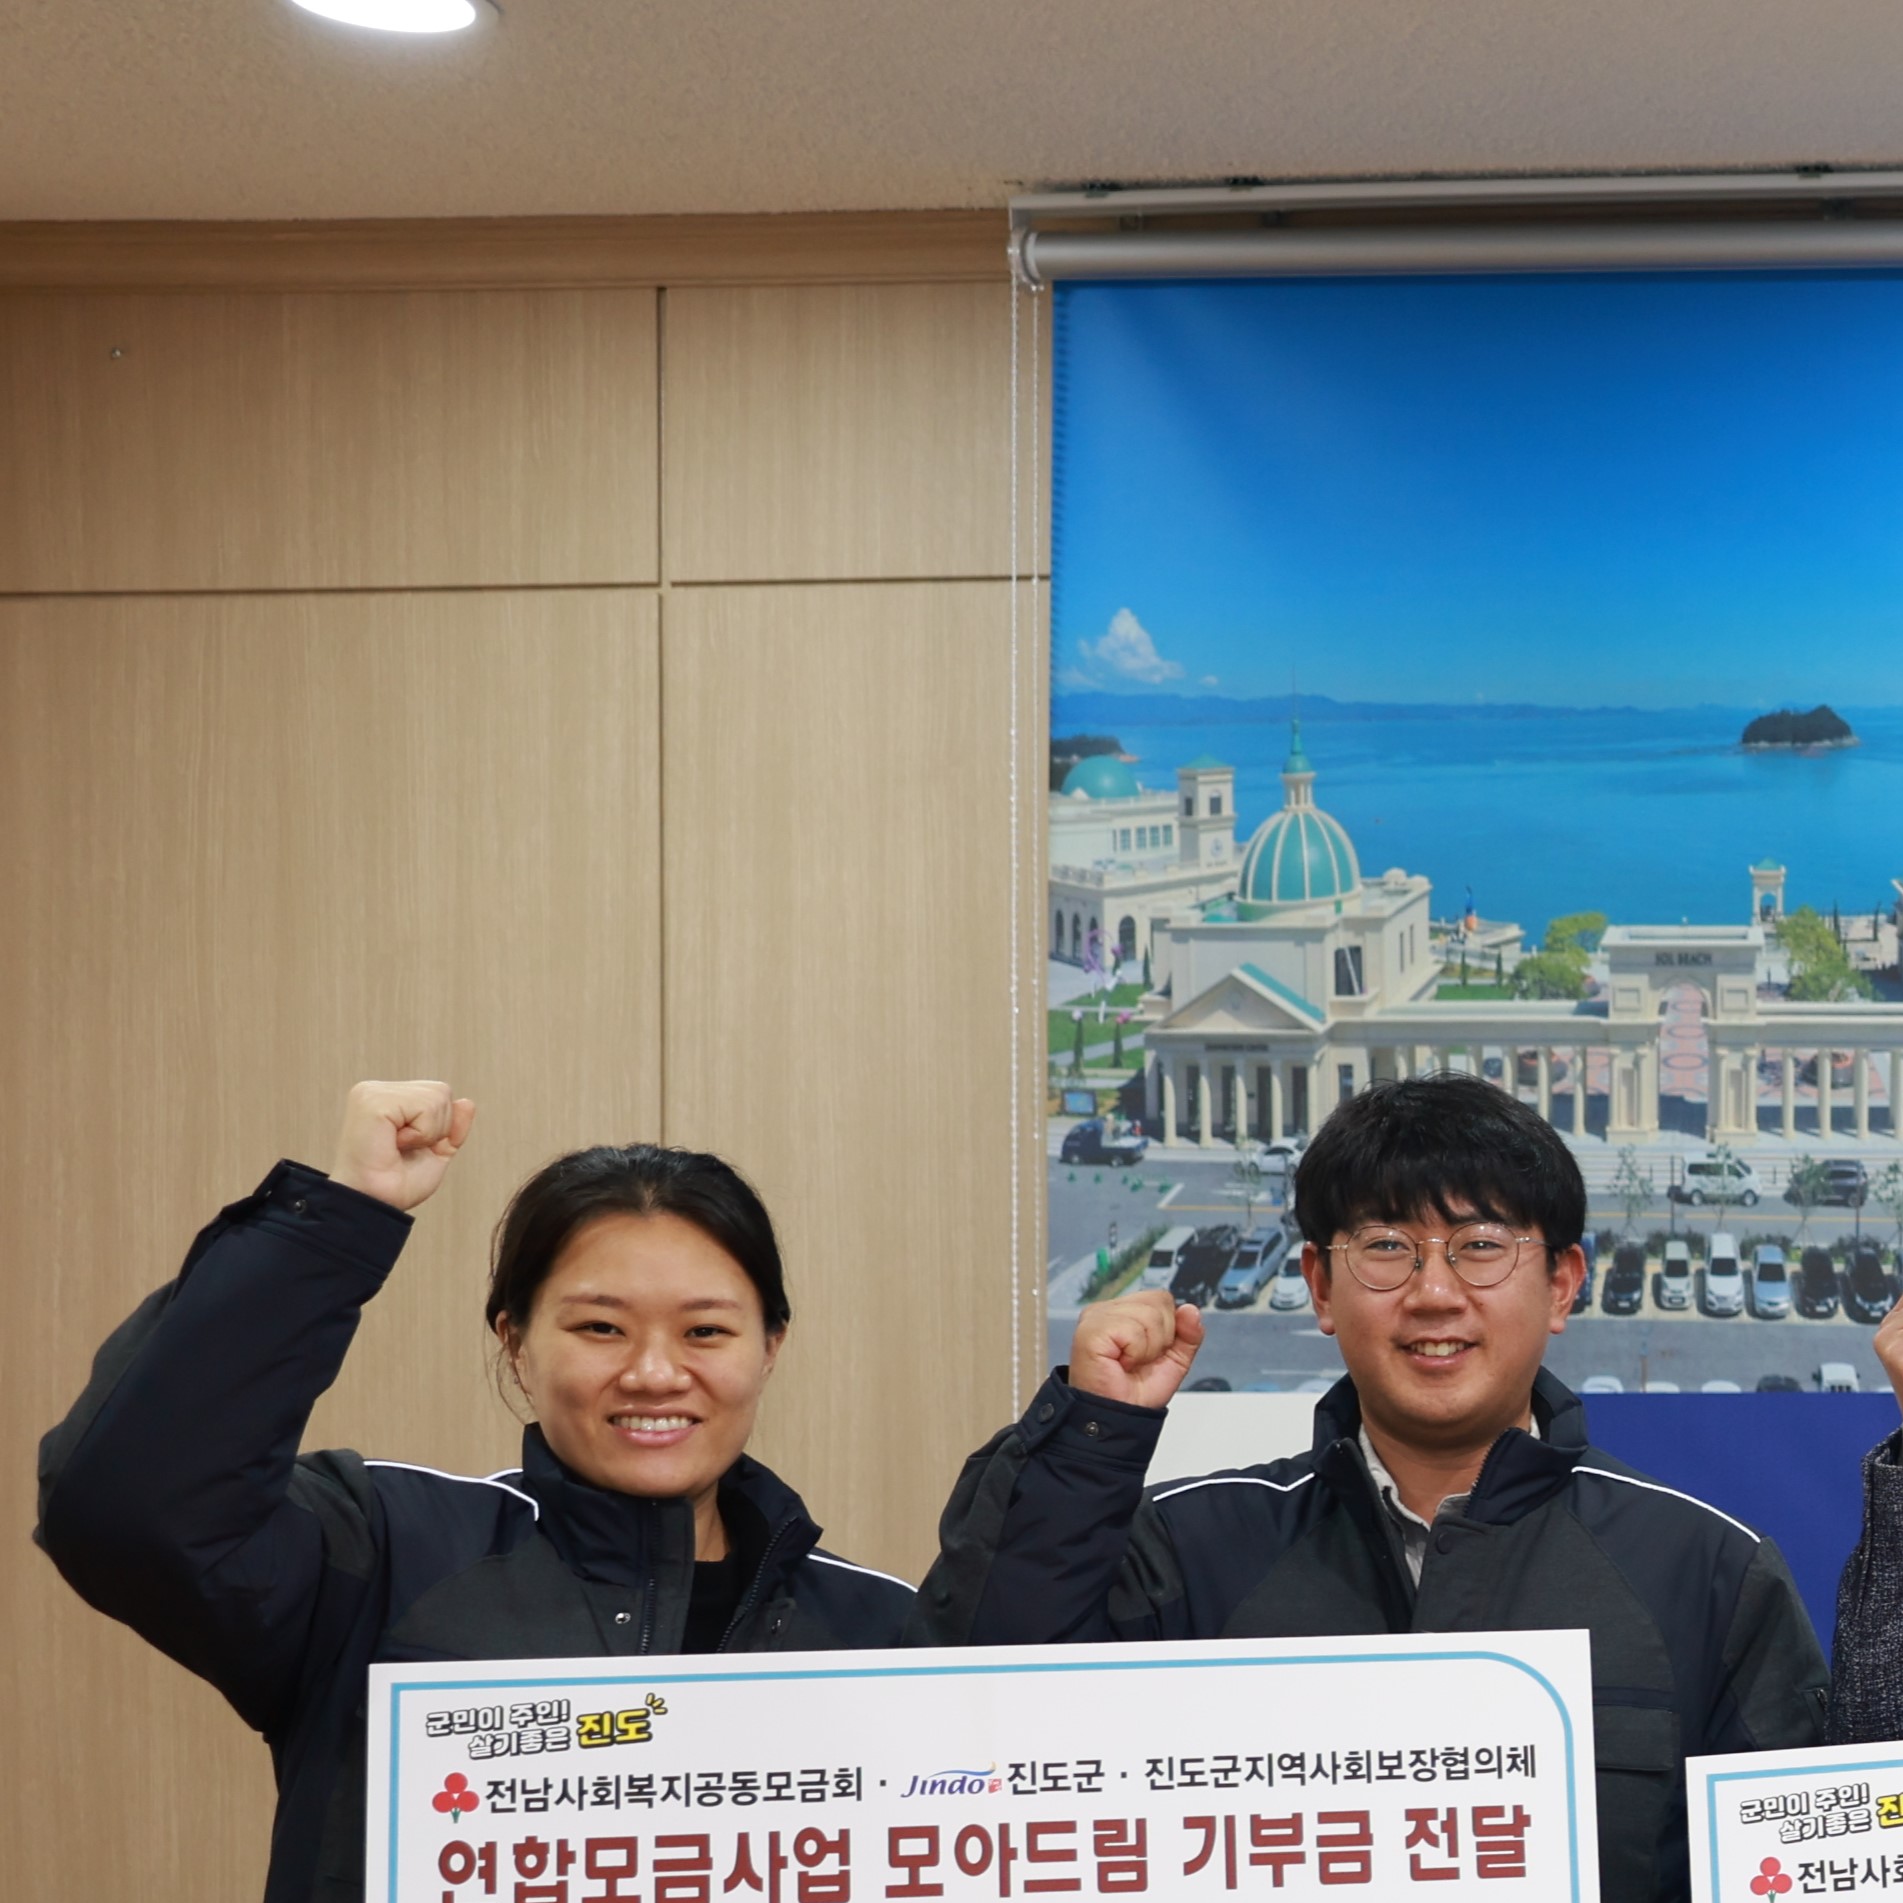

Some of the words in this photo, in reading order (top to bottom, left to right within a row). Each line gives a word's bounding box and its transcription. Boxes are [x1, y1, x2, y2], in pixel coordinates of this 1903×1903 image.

[426, 1706, 503, 1737] 군민이
[510, 1699, 570, 1728] 주인!
[466, 1725, 571, 1760] 살기좋은
[574, 1707, 653, 1750] 진도
[486, 1767, 861, 1813] 전남사회복지공동모금회
[900, 1774, 985, 1798] Jindo
[1008, 1760, 1104, 1795] 진도군
[1145, 1745, 1535, 1790] 진도군지역사회보장협의체
[1741, 1792, 1810, 1824] 군민이
[1816, 1783, 1870, 1812] 주인!
[1778, 1806, 1873, 1844] 살기좋은
[886, 1818, 1147, 1898] 모아드림
[1184, 1811, 1373, 1889] 기부금
[1405, 1805, 1530, 1881] 전달
